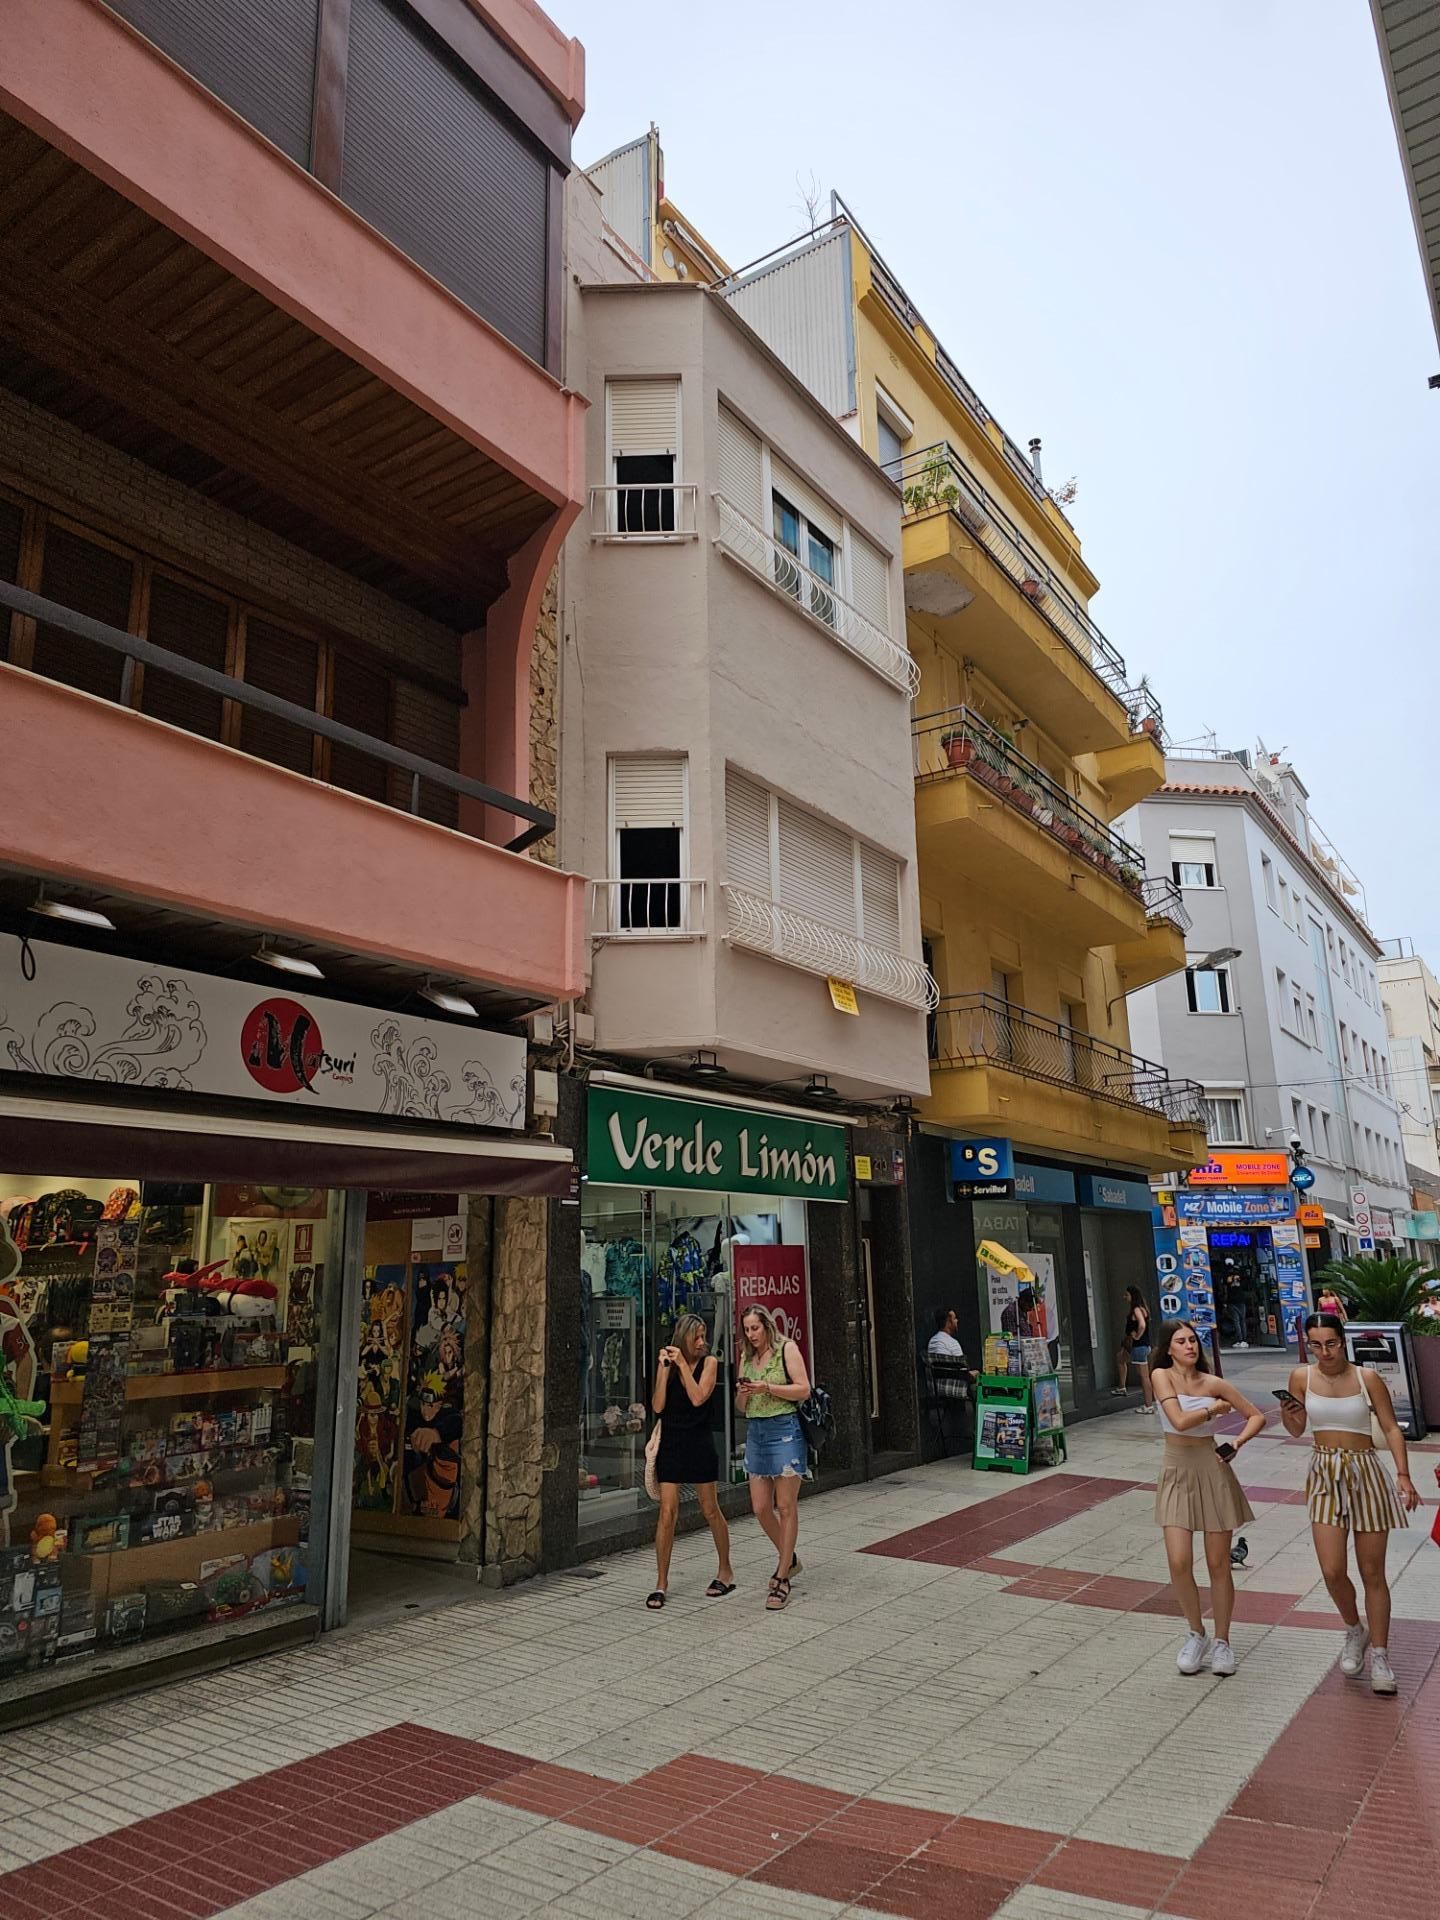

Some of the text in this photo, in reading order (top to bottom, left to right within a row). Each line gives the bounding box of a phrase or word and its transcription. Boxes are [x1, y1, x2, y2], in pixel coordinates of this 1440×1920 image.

[607, 1111, 836, 1187] Verde Limón
[973, 1184, 1007, 1194] ServiRed
[1206, 1201, 1243, 1213] Mobile
[1244, 1201, 1269, 1213] Zone
[739, 1275, 800, 1297] REBAJAS
[157, 1515, 182, 1527] STAR
[152, 1524, 182, 1540] WARS
